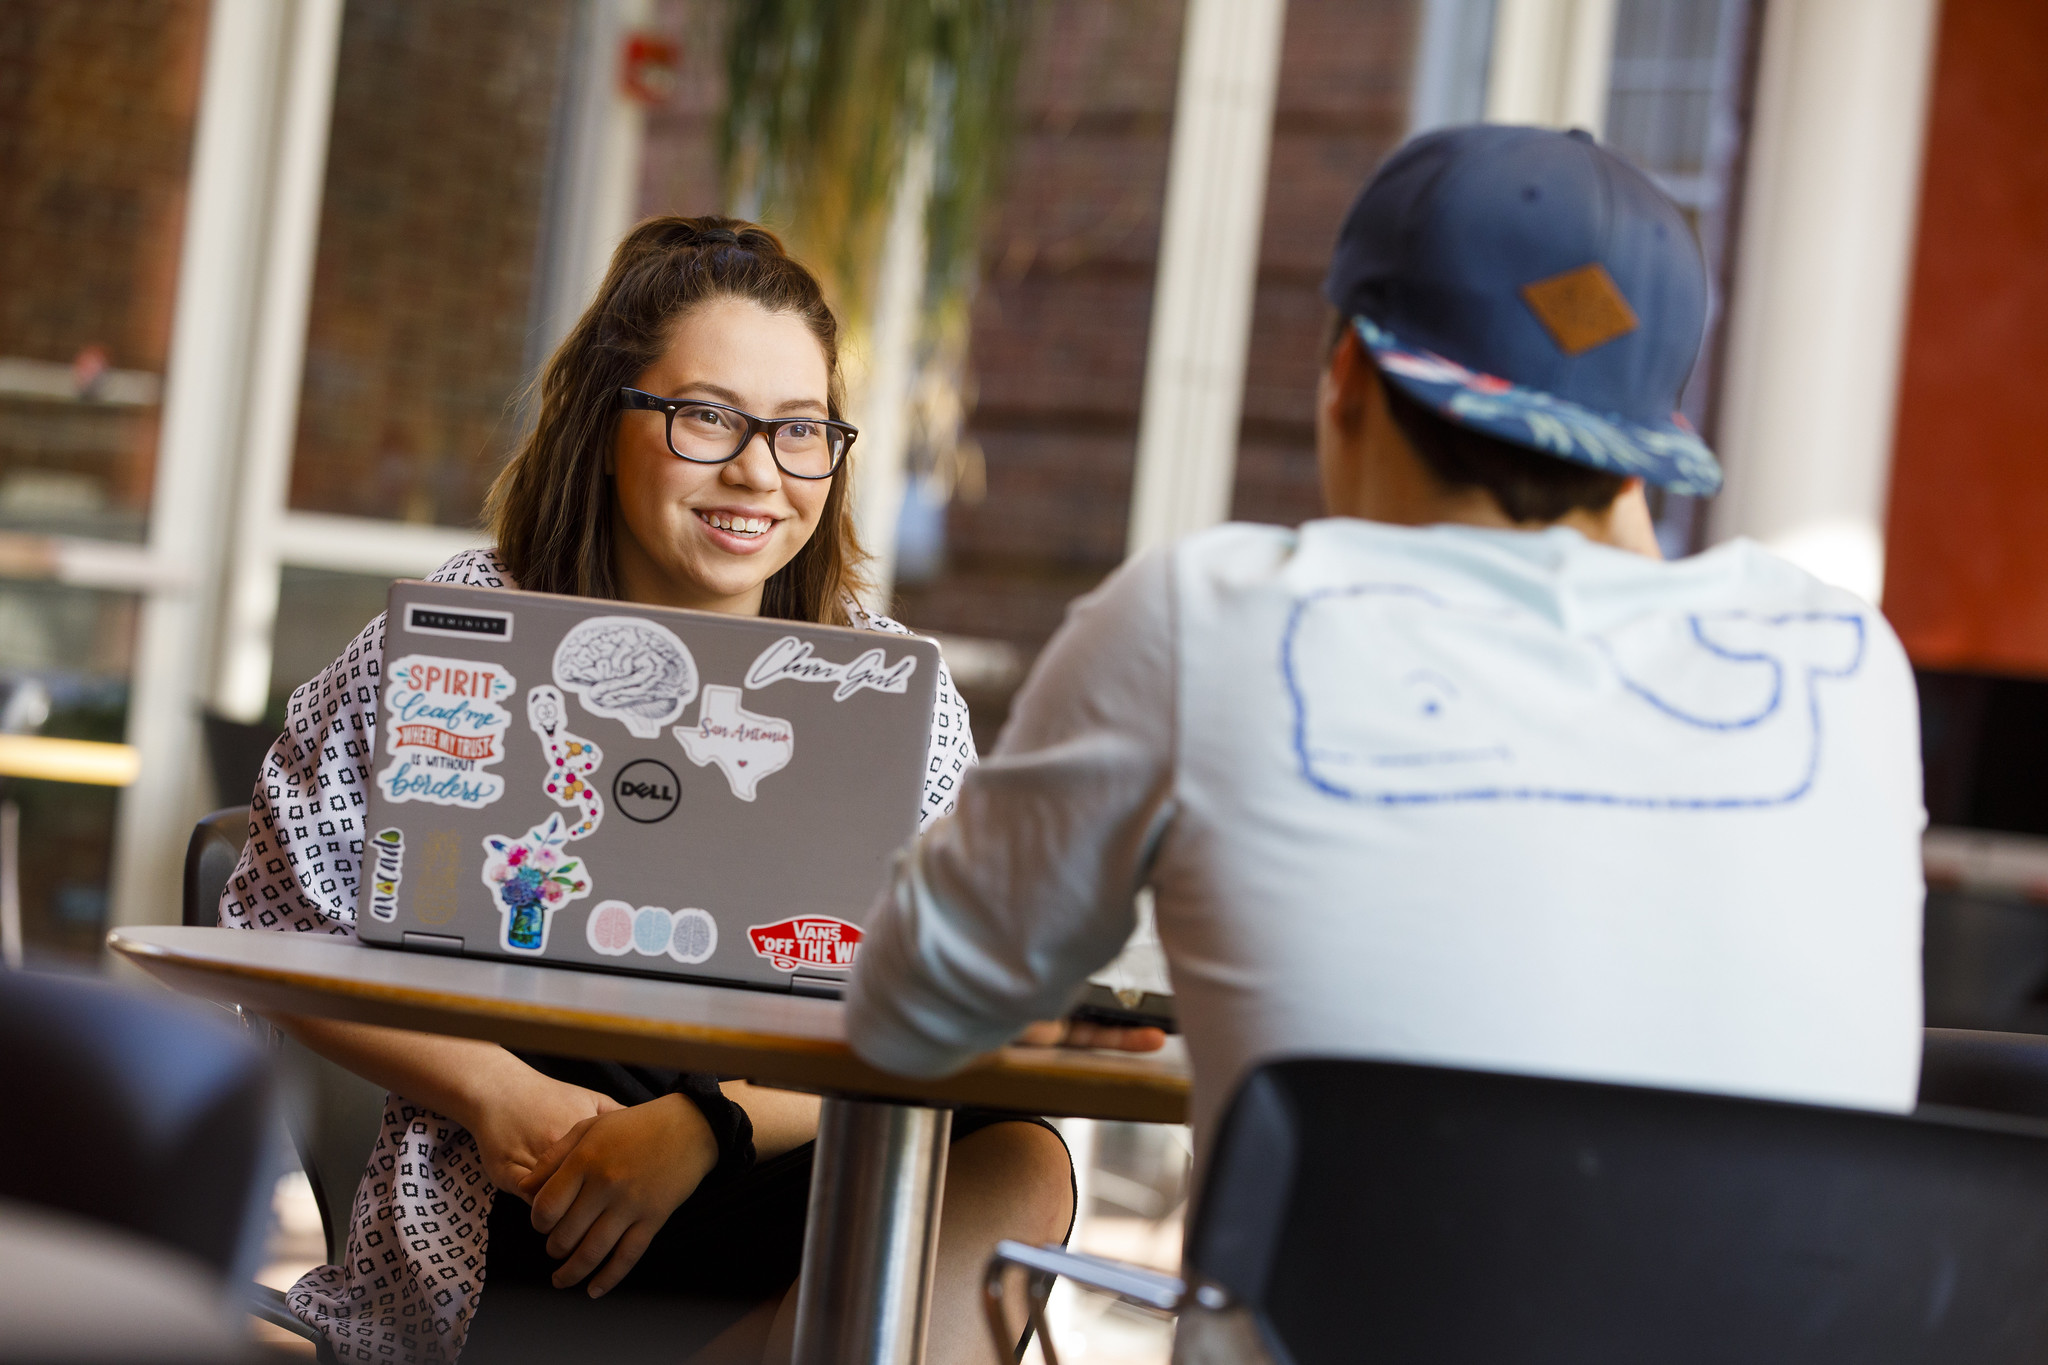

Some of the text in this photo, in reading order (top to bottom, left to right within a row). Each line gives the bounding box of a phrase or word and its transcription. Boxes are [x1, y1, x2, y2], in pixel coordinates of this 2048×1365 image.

[420, 615, 498, 629] STEMINIST
[751, 638, 910, 697] Clever Girl
[408, 664, 495, 699] SPIRIT
[392, 691, 502, 730] lead me
[401, 726, 491, 758] WHERE MY TRUST
[700, 717, 790, 743] San Antonio
[411, 754, 476, 772] IS WITHOUT
[386, 763, 496, 802] borders
[620, 781, 673, 801] DELL
[793, 921, 842, 942] VANS
[797, 939, 832, 963] THE
